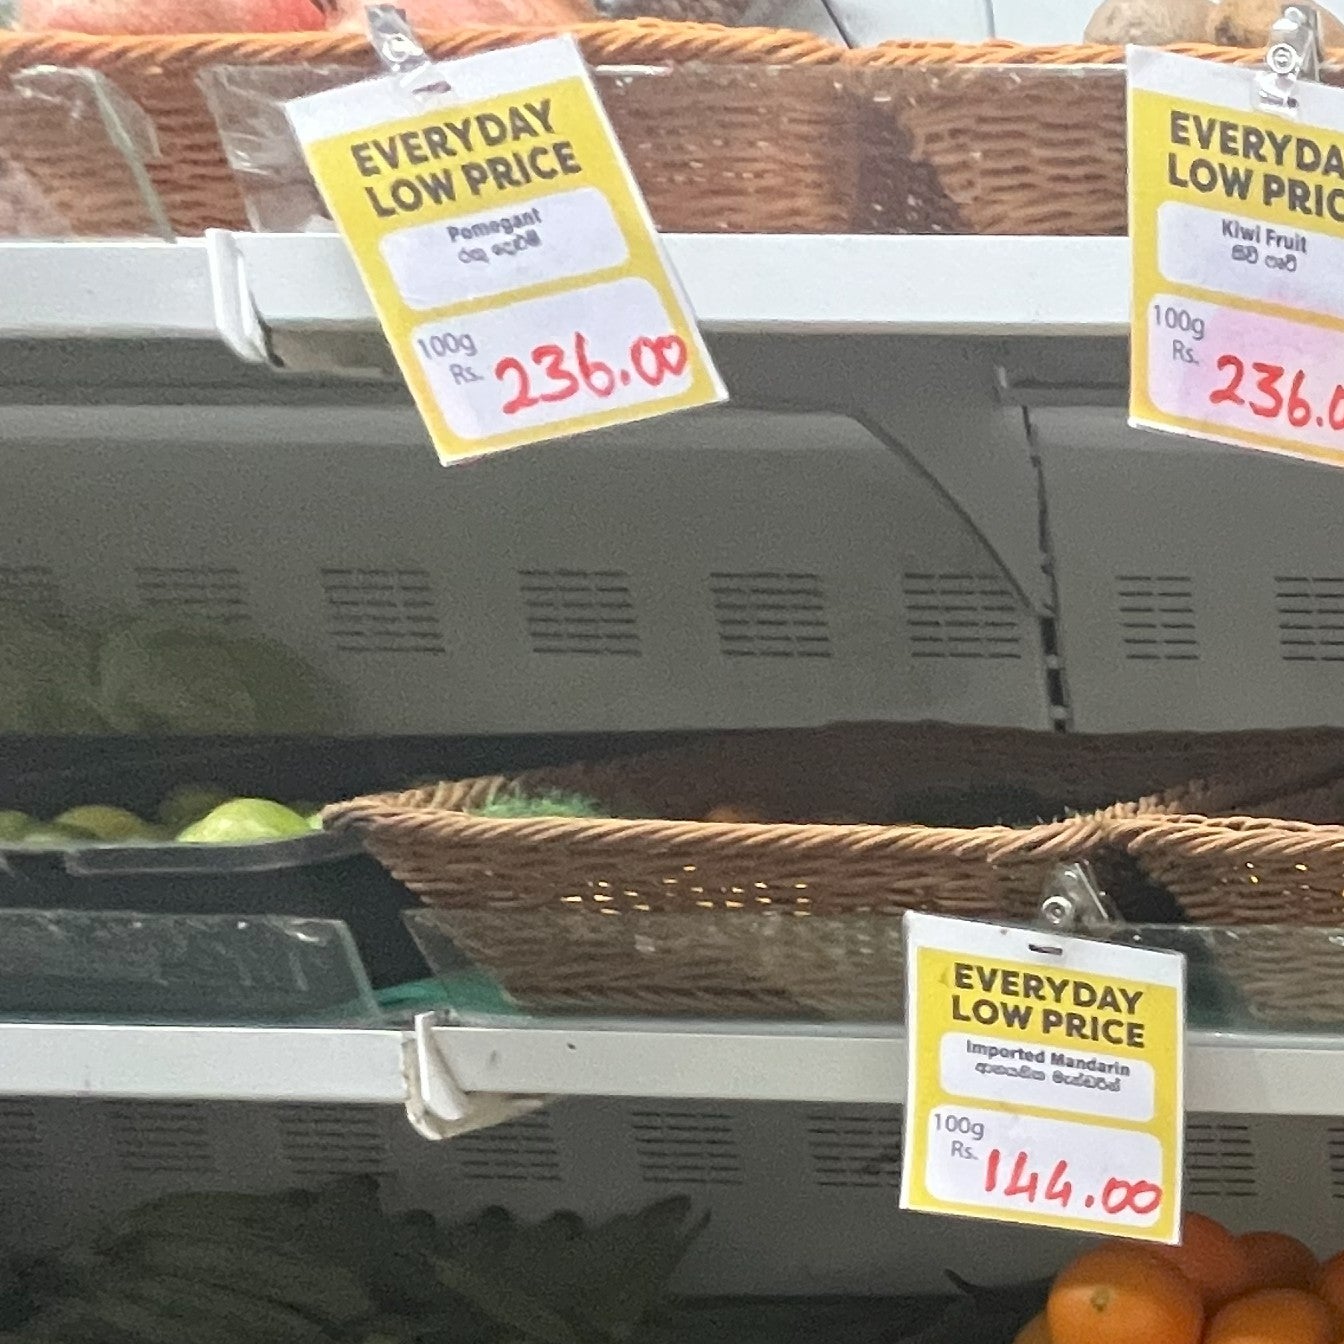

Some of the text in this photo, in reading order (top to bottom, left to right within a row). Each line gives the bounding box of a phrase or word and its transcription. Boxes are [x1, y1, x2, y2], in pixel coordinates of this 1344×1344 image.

[351, 99, 555, 177] EVERYDAY
[365, 141, 581, 219] LOW PRICE
[1168, 153, 1253, 201] LOW
[448, 207, 542, 242] Pomegant
[1221, 219, 1307, 254] Kiwi Fruit
[1154, 305, 1205, 341] 100g
[417, 331, 477, 360] 100g
[494, 331, 688, 414] 236.00
[954, 962, 1144, 1016] EVERYDAY
[951, 995, 1146, 1048] LOW PRICE
[966, 1039, 1131, 1077] Imported Mandarin
[934, 1113, 985, 1139] 100g
[951, 1140, 978, 1160] Rs.
[984, 1149, 1163, 1214] 144.00
